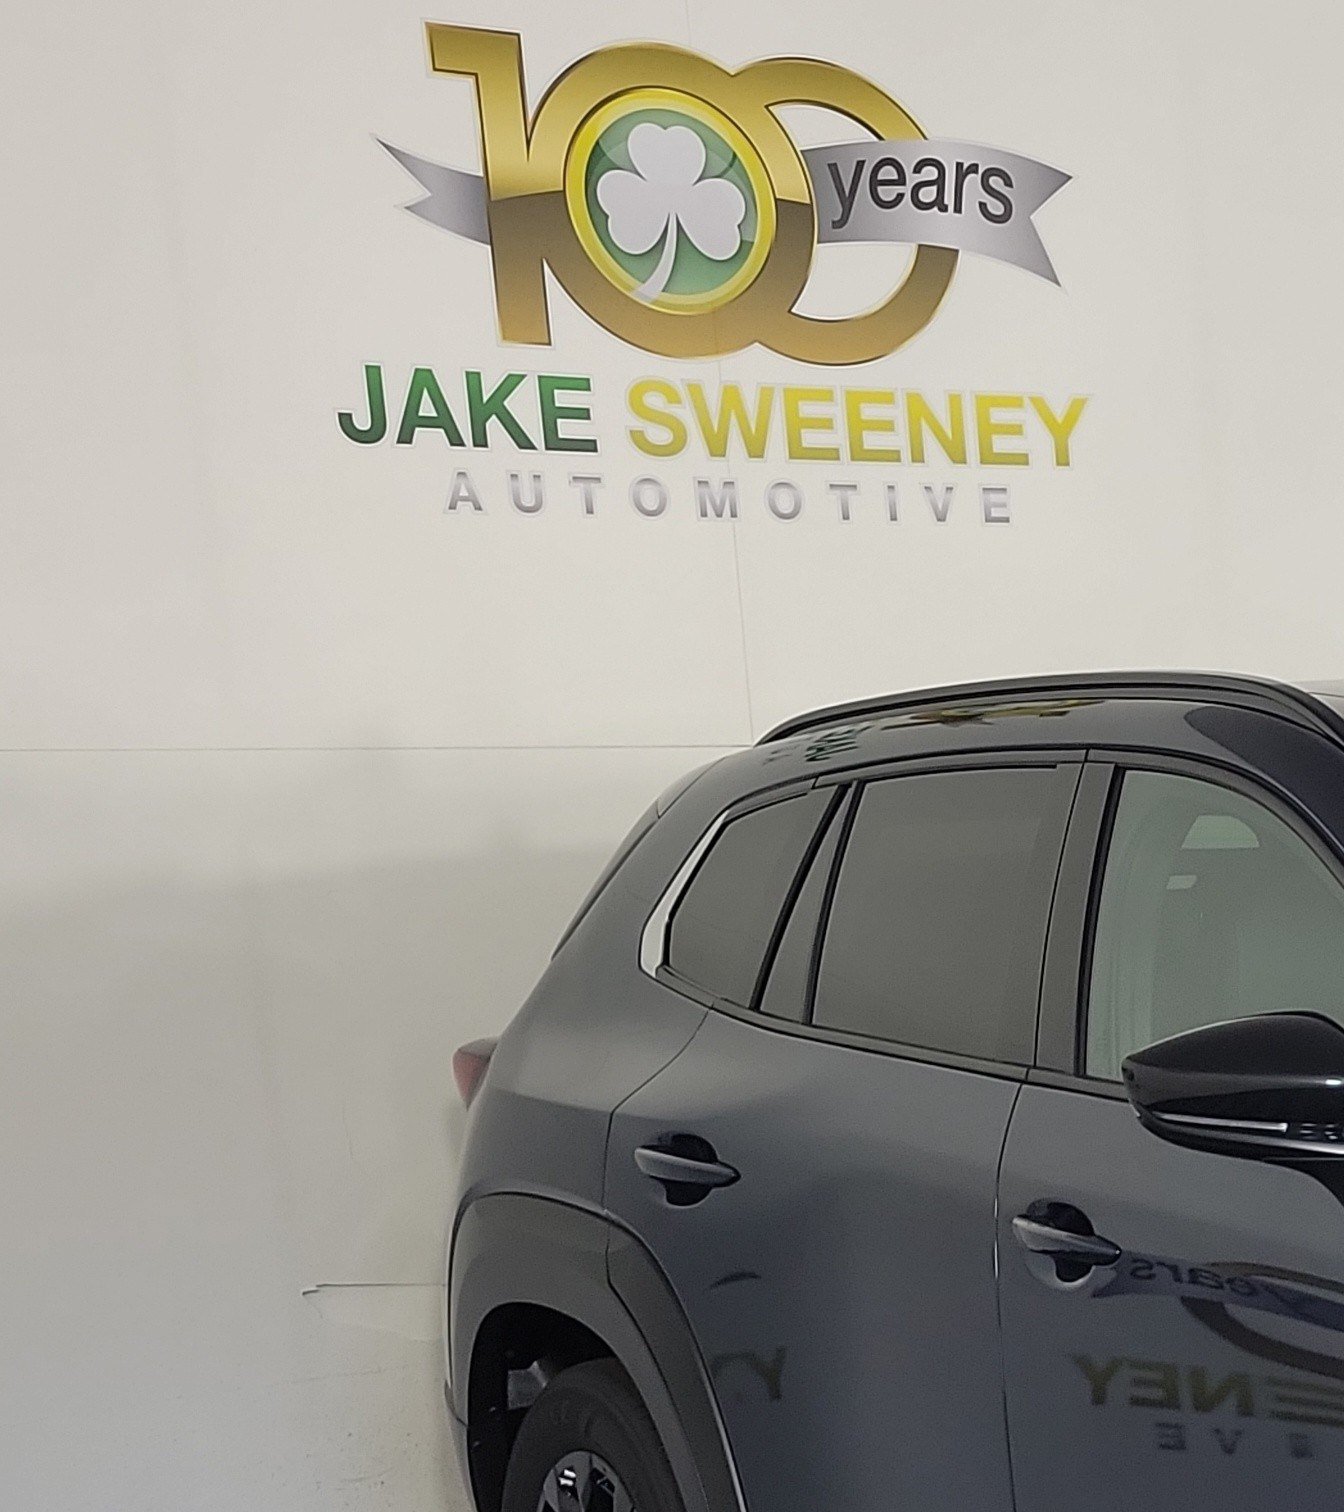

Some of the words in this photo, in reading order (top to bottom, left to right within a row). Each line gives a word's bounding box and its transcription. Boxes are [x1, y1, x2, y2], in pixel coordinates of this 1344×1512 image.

[827, 156, 1015, 229] years
[337, 364, 599, 453] JAKE
[628, 380, 1089, 468] SWEENEY
[447, 471, 1011, 523] AUTOMOTIVE
